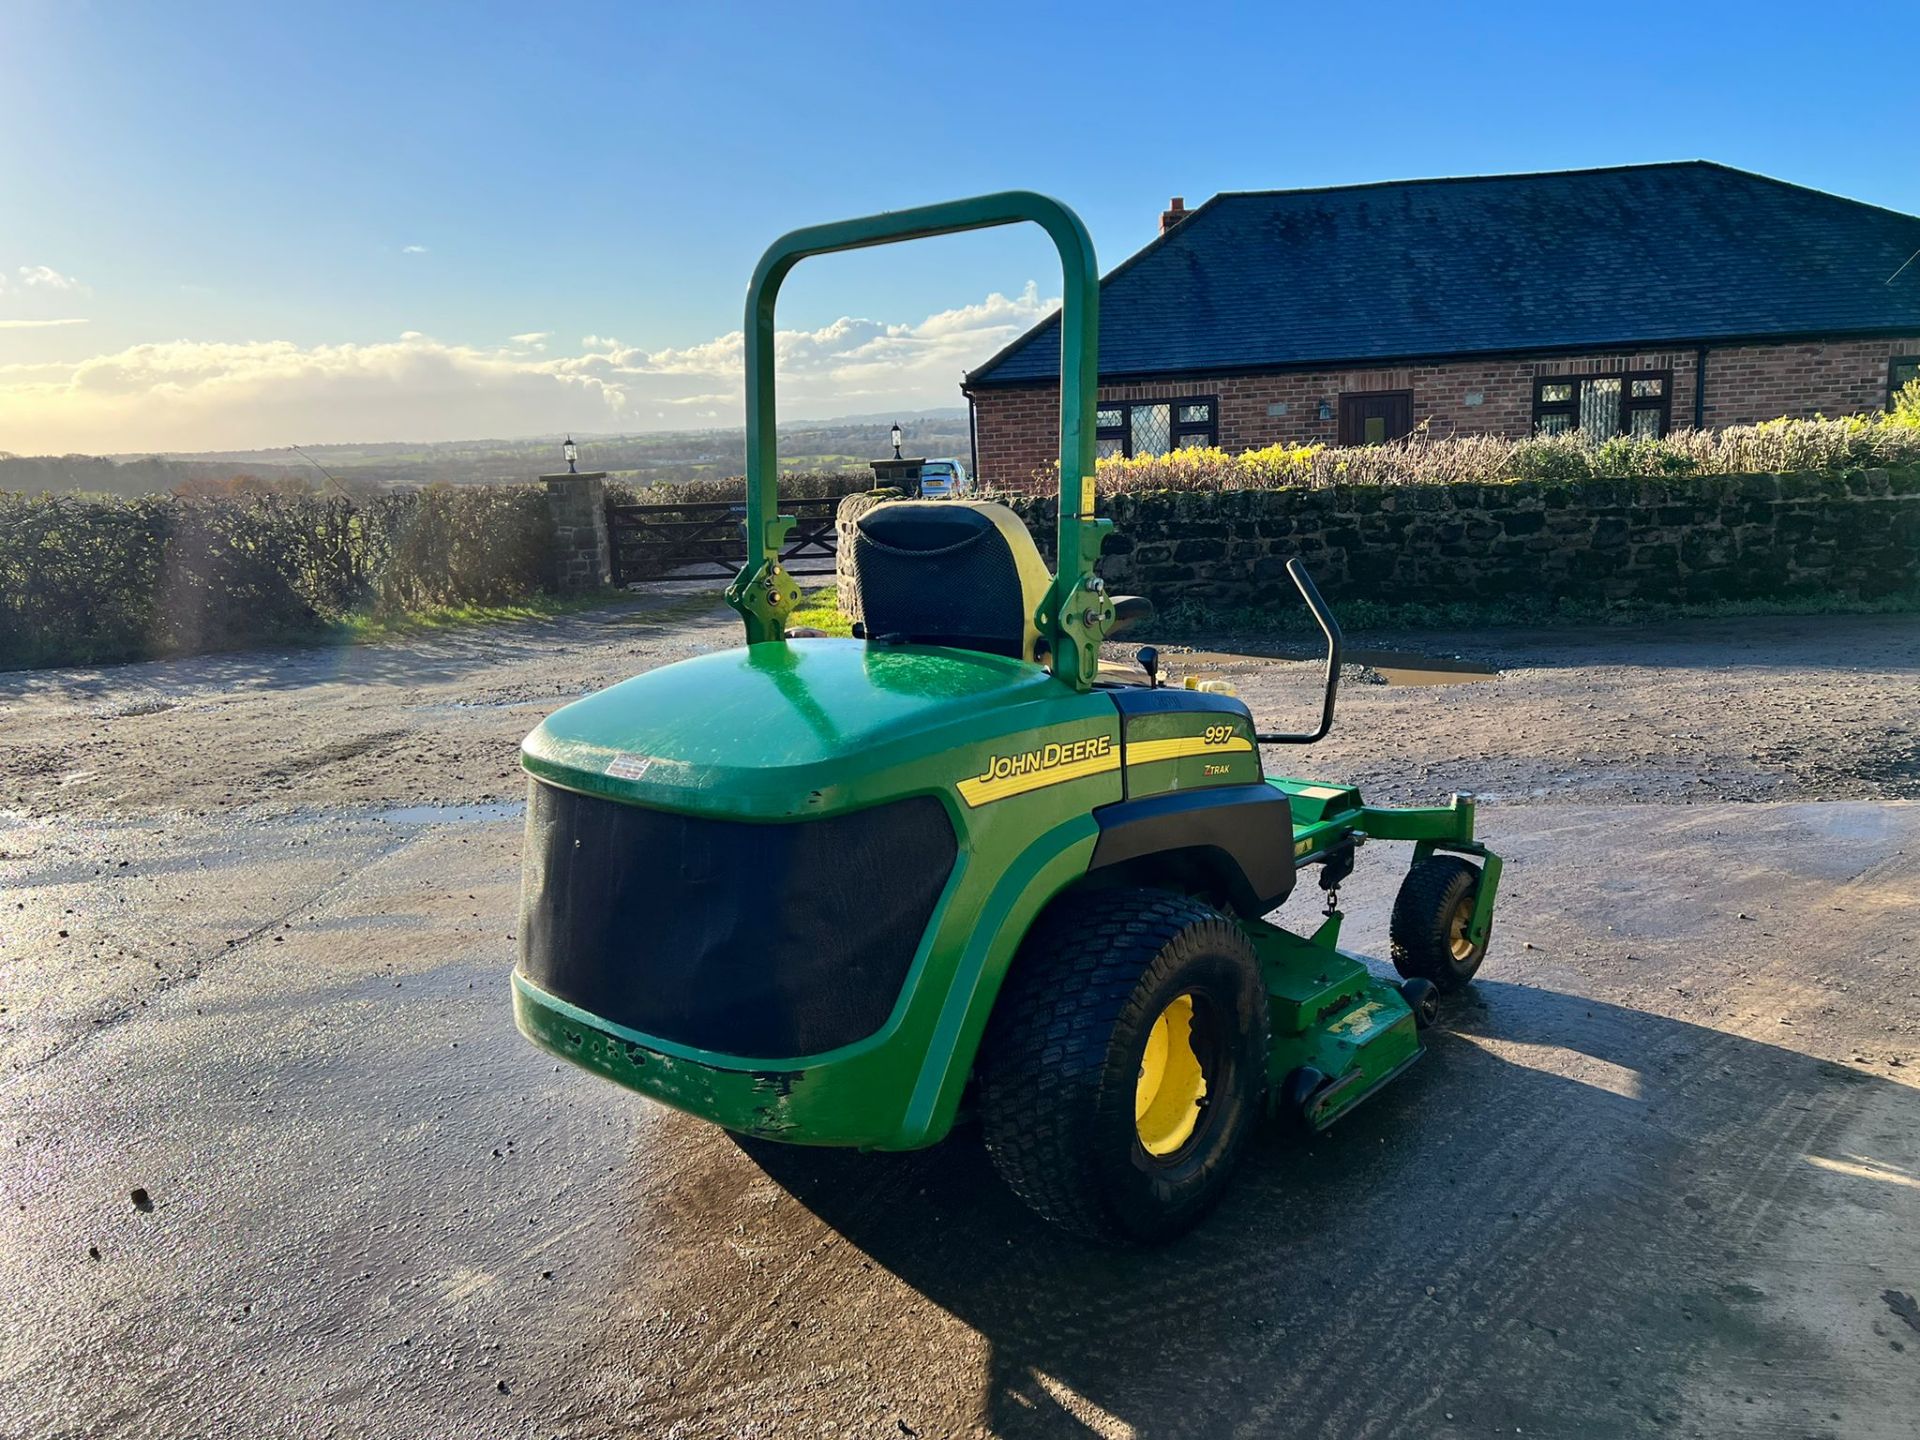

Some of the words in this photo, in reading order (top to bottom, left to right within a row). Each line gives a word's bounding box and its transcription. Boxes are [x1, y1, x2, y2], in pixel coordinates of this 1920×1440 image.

[1204, 725, 1234, 744] 997
[979, 750, 1042, 782] JOHN
[1042, 735, 1111, 769] DEERE
